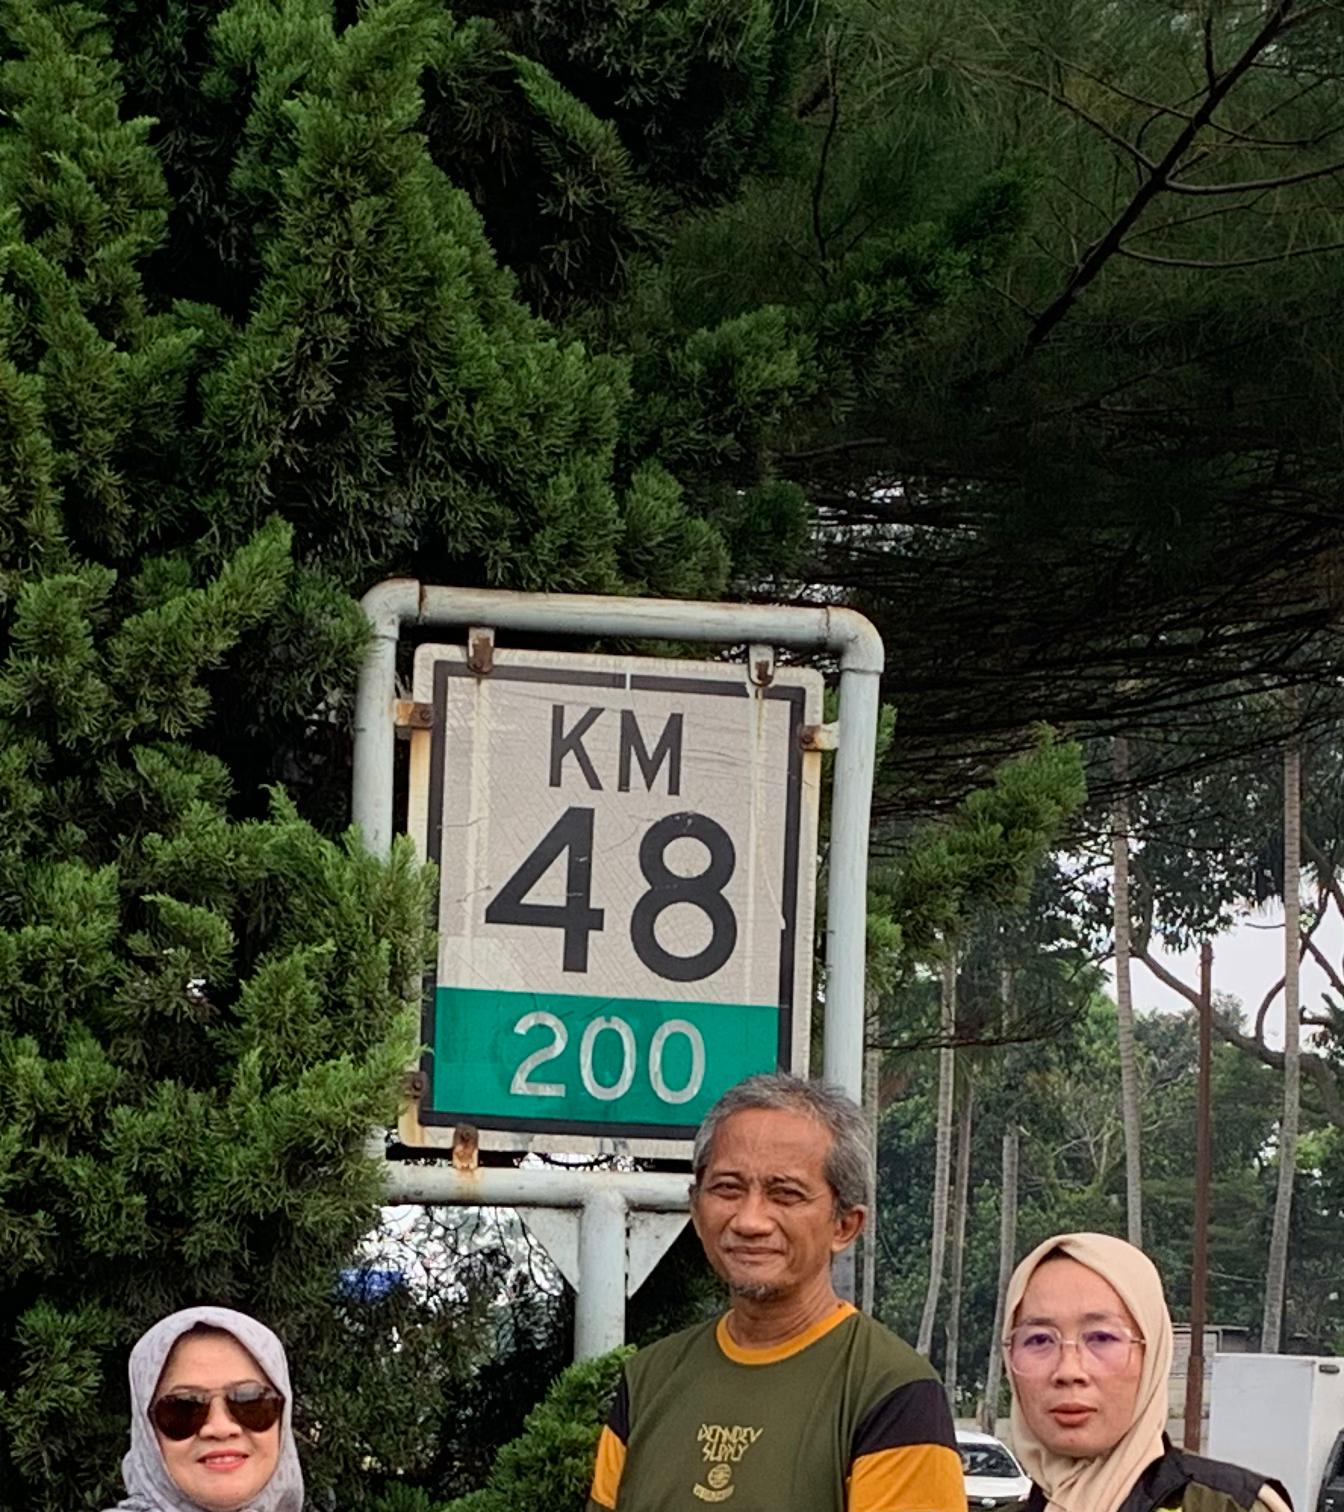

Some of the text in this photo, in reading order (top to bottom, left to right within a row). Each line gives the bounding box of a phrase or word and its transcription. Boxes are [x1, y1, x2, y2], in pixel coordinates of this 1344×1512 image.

[549, 704, 684, 796] KM
[485, 806, 738, 983] 48
[509, 1011, 706, 1104] 200
